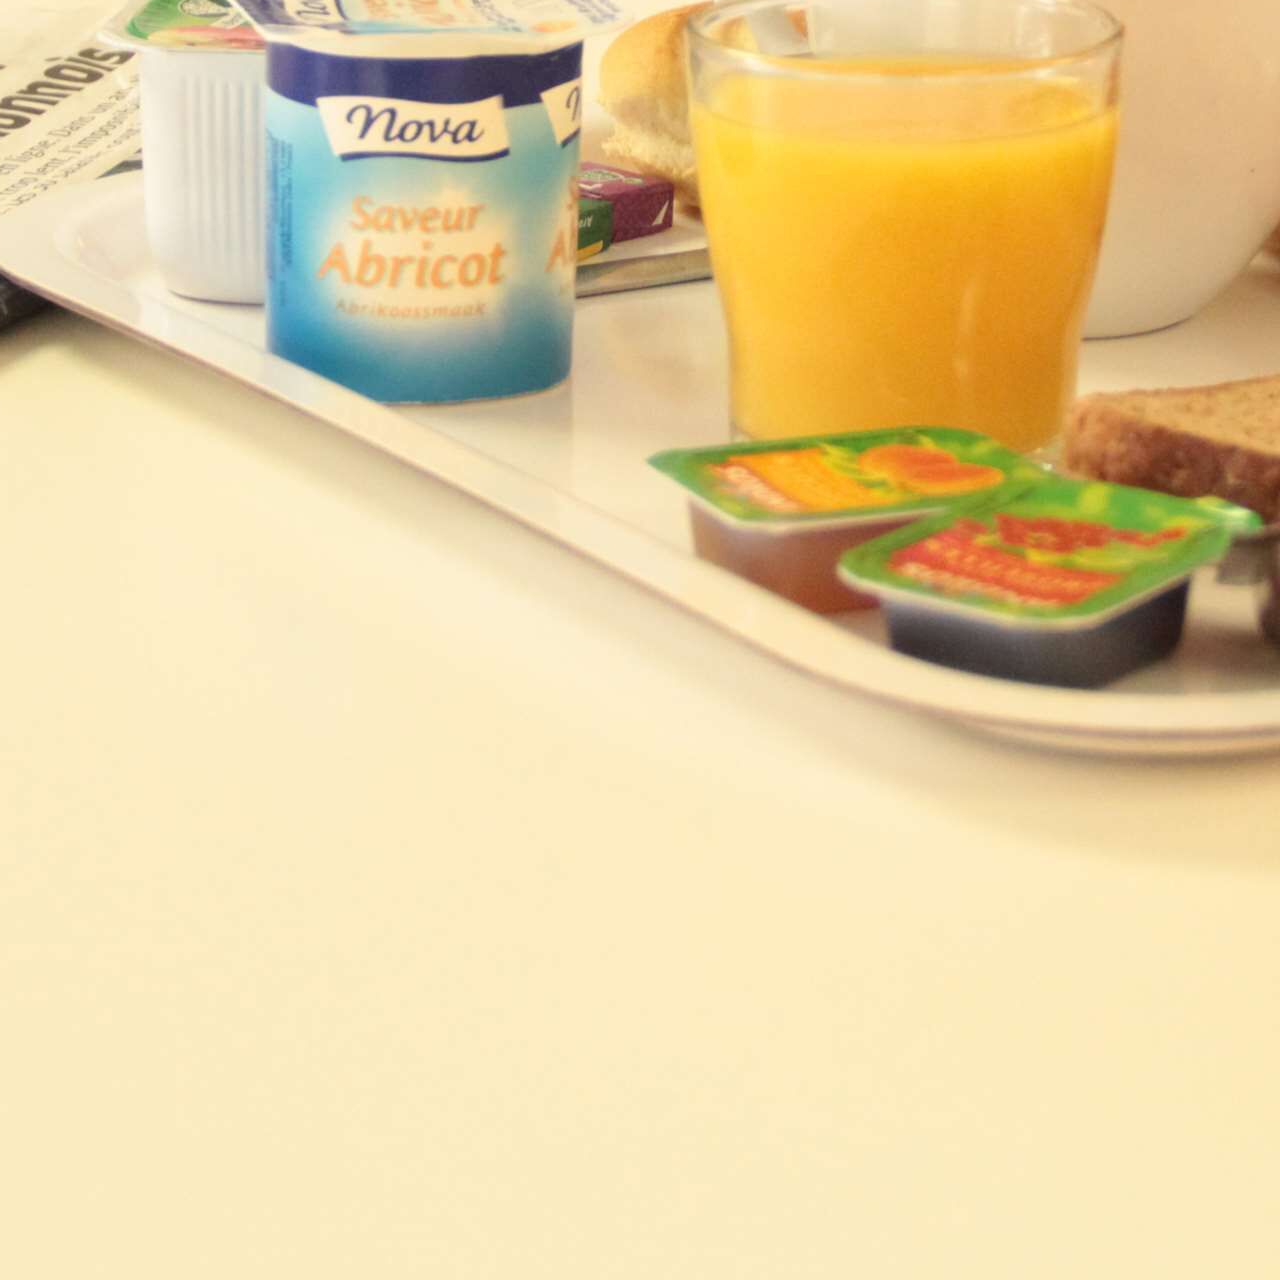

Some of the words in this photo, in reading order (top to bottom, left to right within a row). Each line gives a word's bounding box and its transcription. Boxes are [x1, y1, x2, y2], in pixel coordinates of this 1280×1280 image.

[345, 103, 486, 145] Nova
[350, 196, 487, 235] Saveur
[317, 239, 509, 290] Abricot
